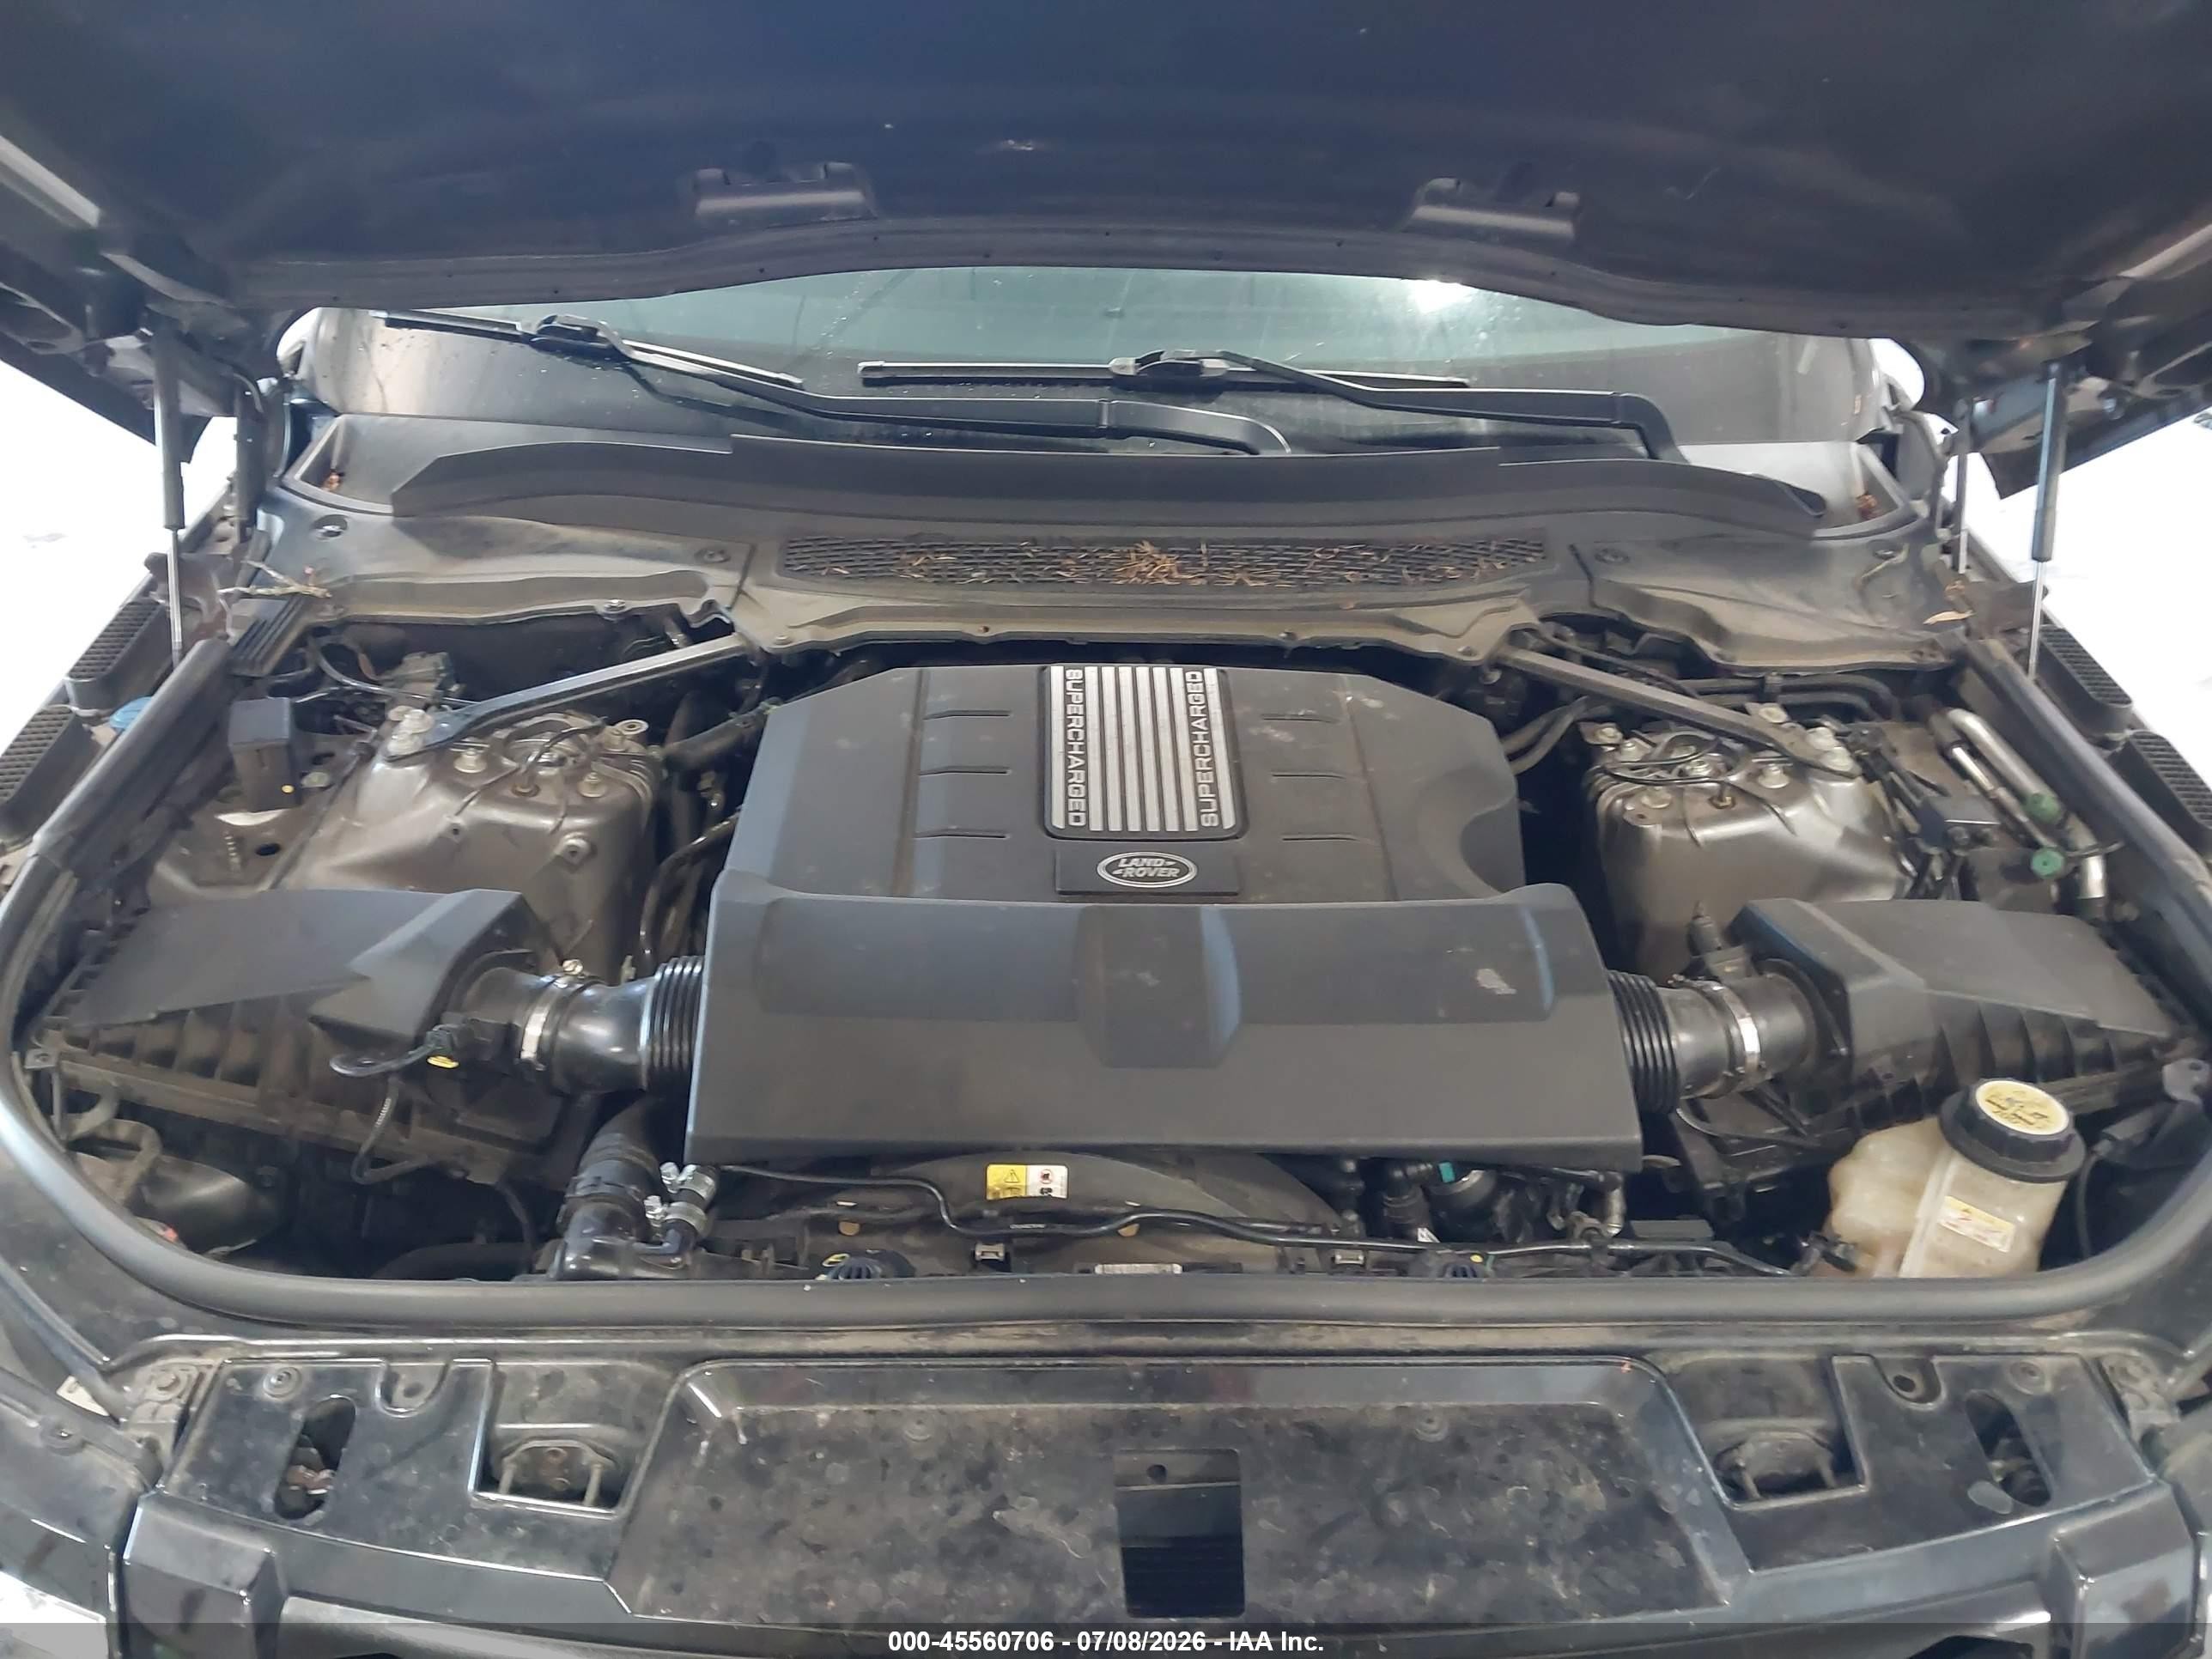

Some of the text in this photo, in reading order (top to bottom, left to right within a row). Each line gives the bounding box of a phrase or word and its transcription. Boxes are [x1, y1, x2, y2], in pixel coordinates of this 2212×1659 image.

[1066, 669, 1086, 826] SUPERCHARGED
[1185, 671, 1218, 827] SUPERCHARGED
[1118, 858, 1164, 867] LAND
[1122, 867, 1180, 878] ROVER
